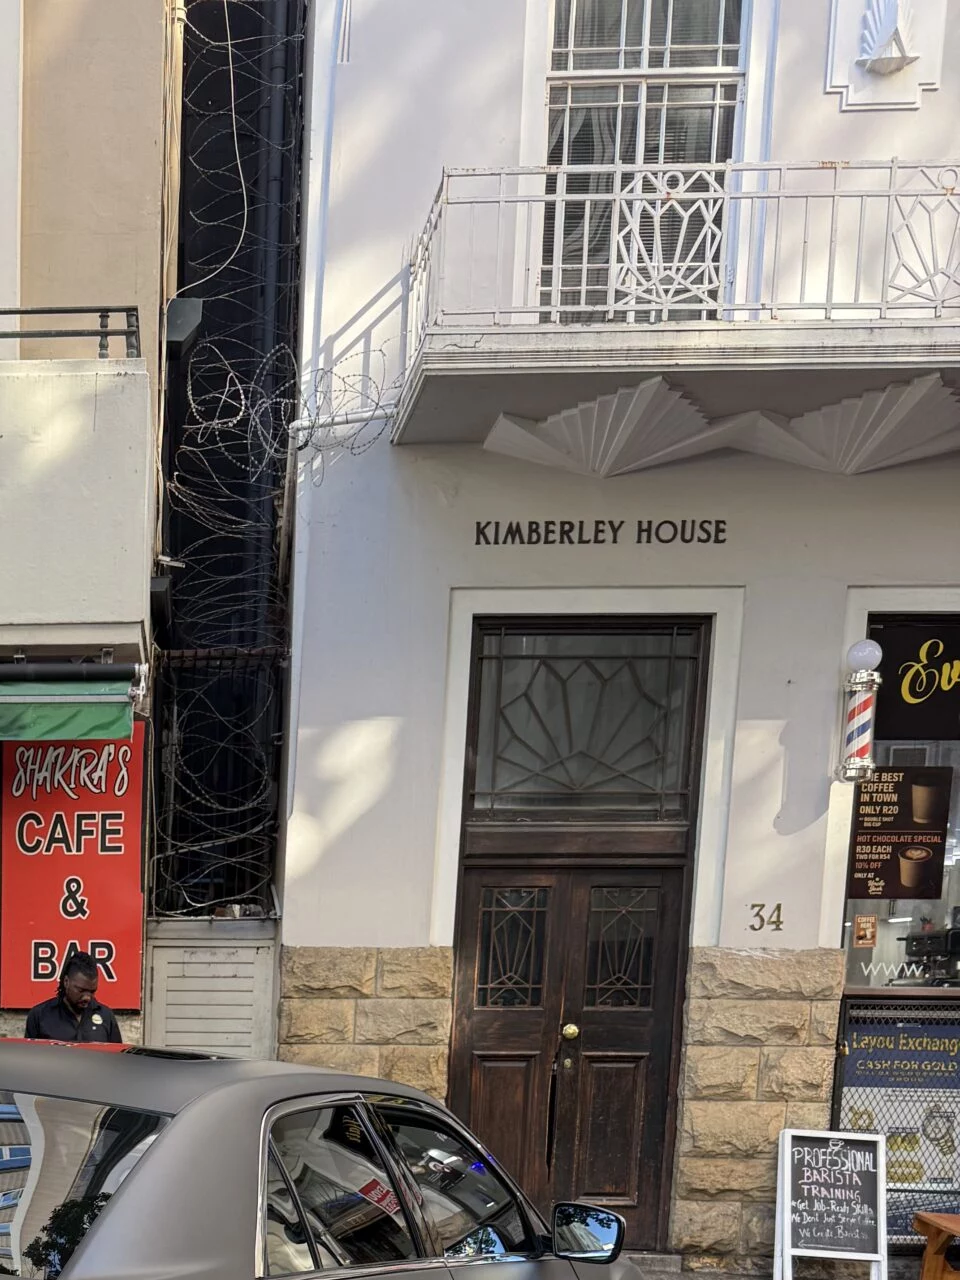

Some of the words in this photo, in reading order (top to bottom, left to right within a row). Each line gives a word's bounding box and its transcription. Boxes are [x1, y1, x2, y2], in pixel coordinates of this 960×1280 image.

[474, 520, 626, 546] KIMBERLEY
[636, 519, 728, 545] HOUSE
[12, 744, 132, 801] SHAKIRA'S
[881, 772, 905, 782] BEST
[861, 783, 895, 793] COFFEE
[860, 793, 870, 803] IN
[872, 793, 898, 803] TOWN
[859, 805, 881, 815] ONLY
[882, 805, 899, 815] R20
[16, 810, 125, 856] CAFE
[856, 834, 871, 843] HOT
[872, 834, 912, 843] CHOCOLATE
[913, 835, 943, 843] SPECIAL
[855, 845, 871, 854] R30
[872, 845, 892, 854] EACH
[855, 861, 869, 869] 10%
[870, 861, 881, 869] OFF
[59, 875, 90, 921] &
[749, 903, 784, 931] 34
[851, 1031, 895, 1054] Layou
[898, 1033, 960, 1056] Exchang
[856, 1060, 890, 1070] CASH
[893, 1060, 918, 1070] FOR
[922, 1061, 958, 1071] GOLD
[792, 1146, 877, 1173] PROFESSIONAL
[798, 1166, 862, 1186] BARISTA
[800, 1184, 862, 1203] TRAINING
